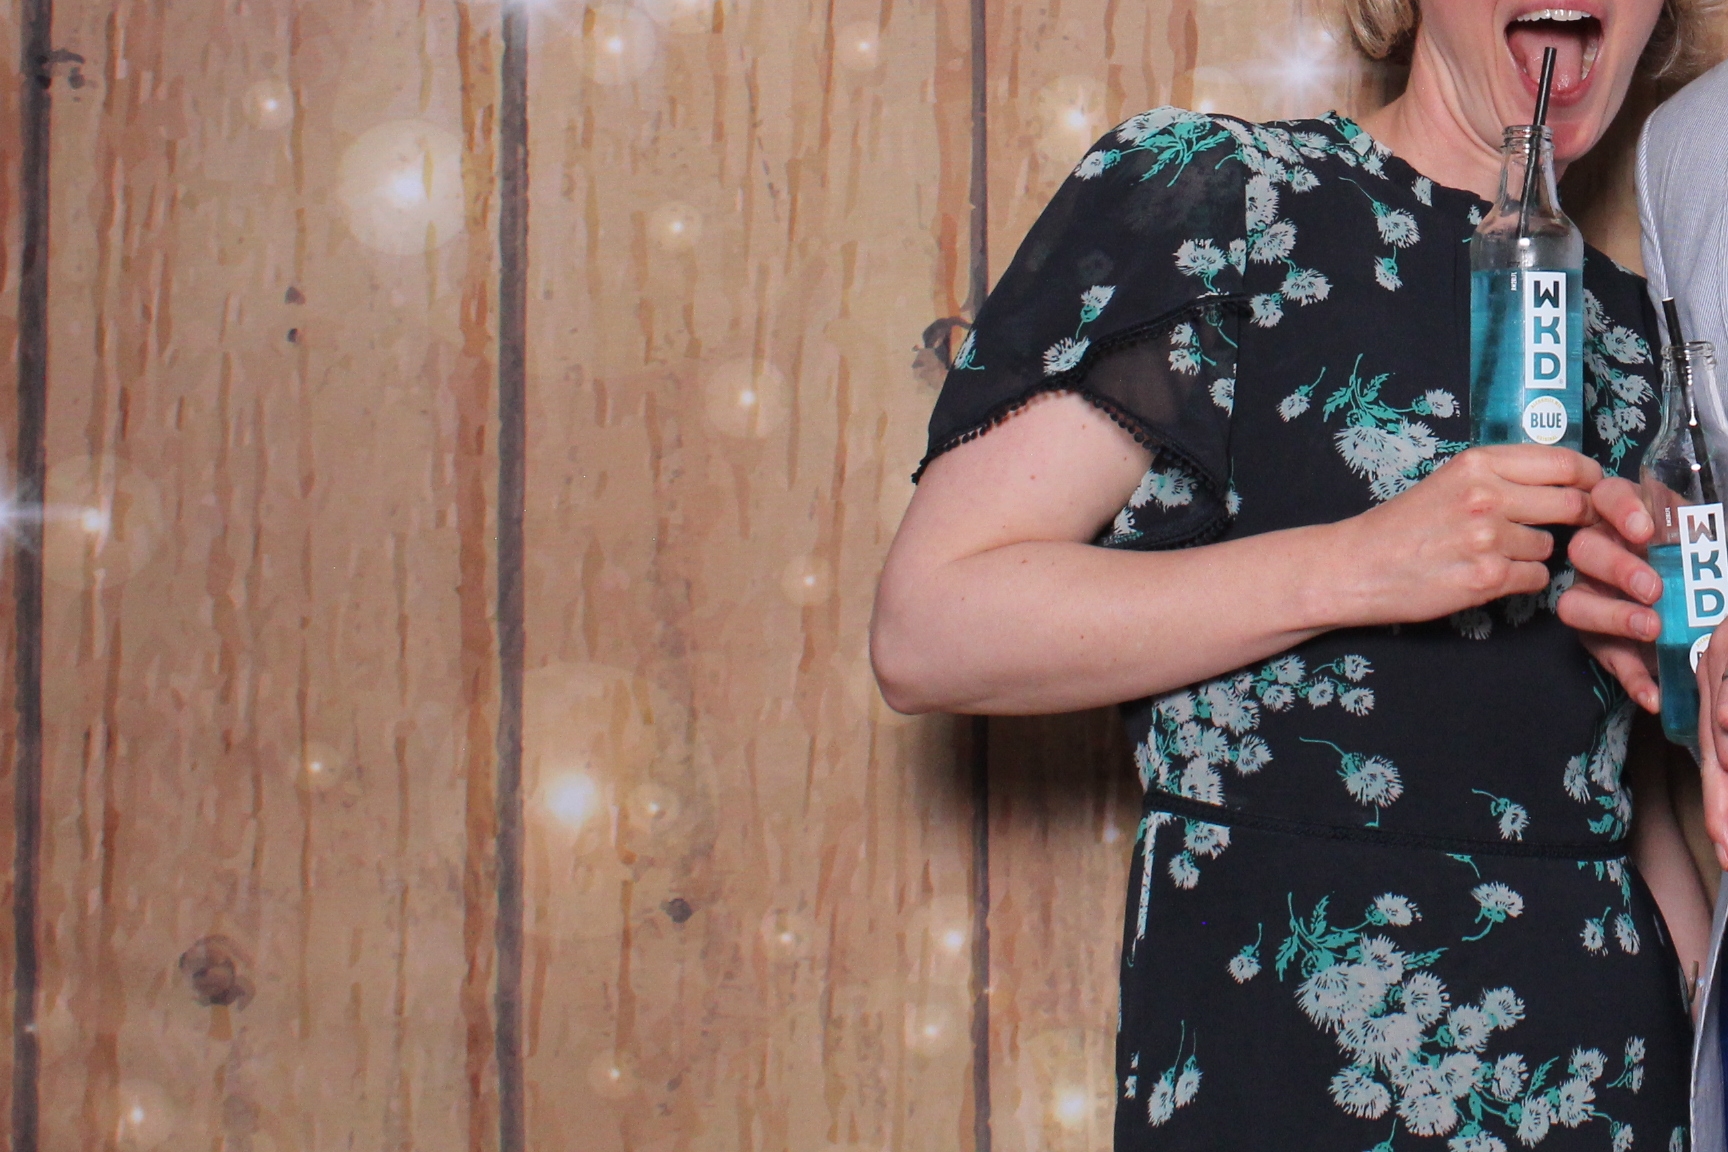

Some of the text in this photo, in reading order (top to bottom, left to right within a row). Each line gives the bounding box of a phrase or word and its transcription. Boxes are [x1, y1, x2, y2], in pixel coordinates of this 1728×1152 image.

[1533, 280, 1561, 381] WKD
[1530, 412, 1562, 429] BLUE
[1686, 512, 1726, 619] WKD
